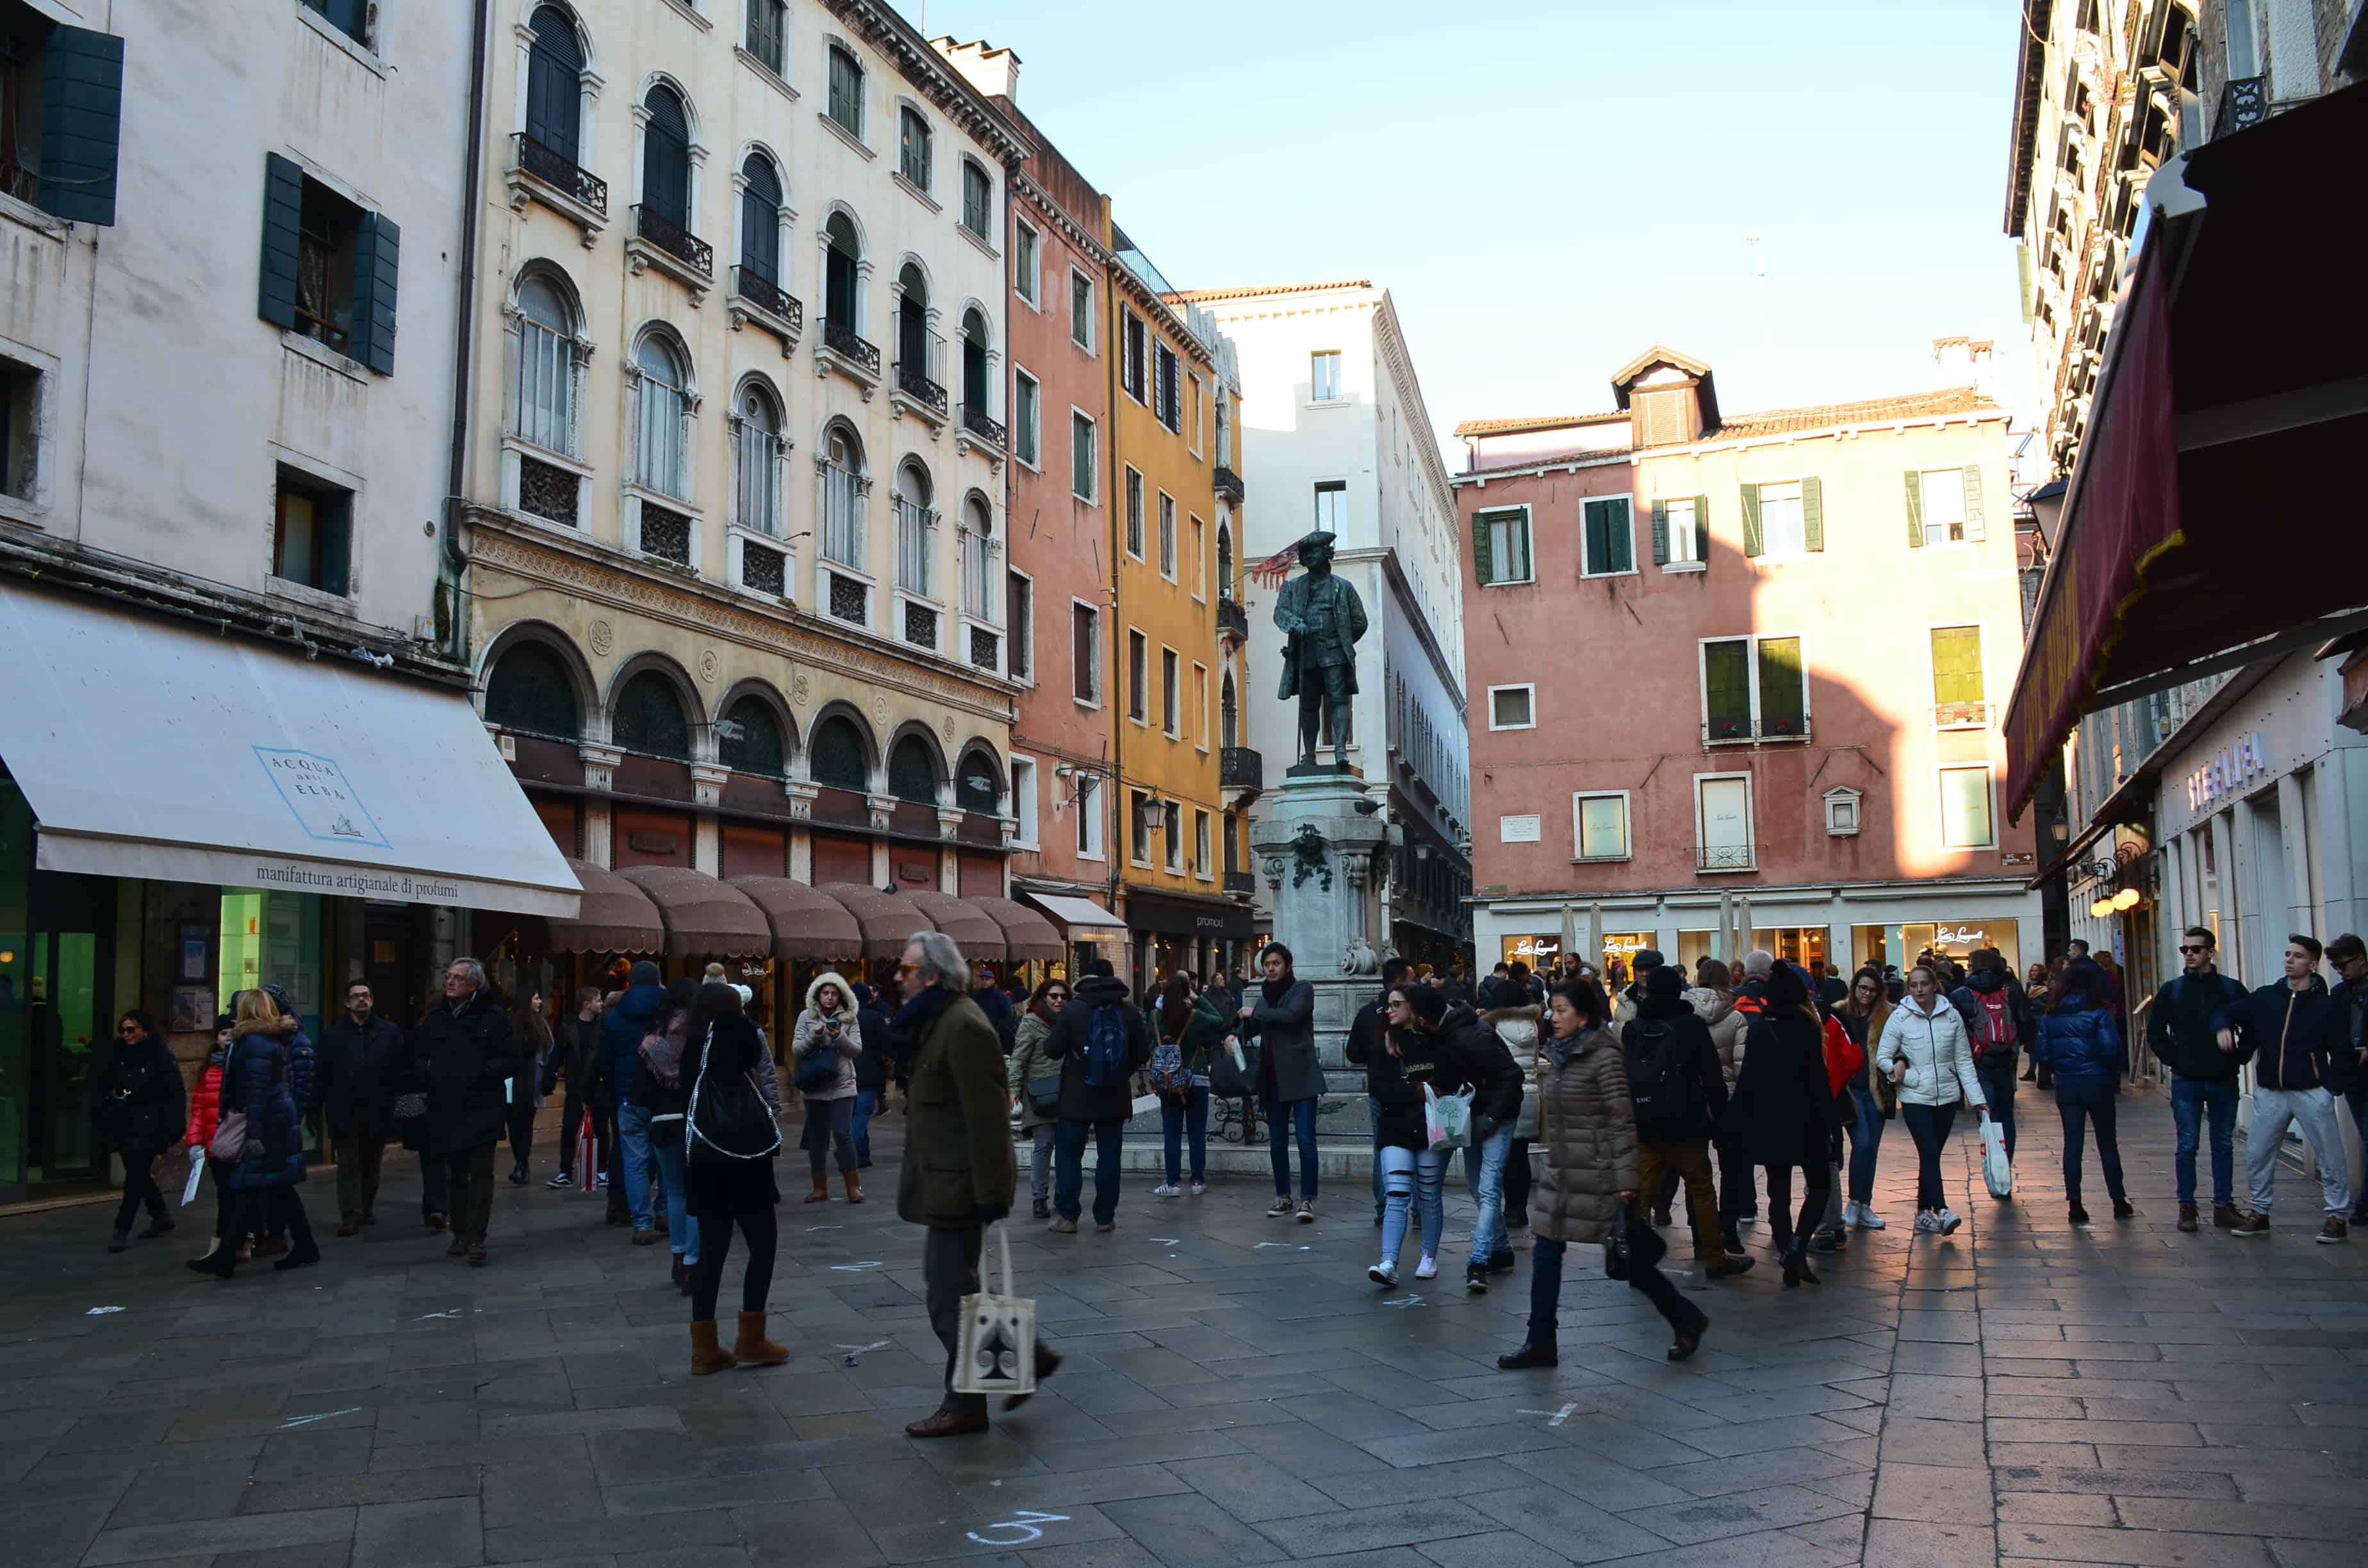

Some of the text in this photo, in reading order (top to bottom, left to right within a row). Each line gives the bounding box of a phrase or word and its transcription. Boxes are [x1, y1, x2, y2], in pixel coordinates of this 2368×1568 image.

[272, 758, 334, 776] ACQUA
[295, 785, 341, 799] ELBA
[257, 866, 458, 899] manifattura artigianale di profumi
[1197, 917, 1223, 928] promod
